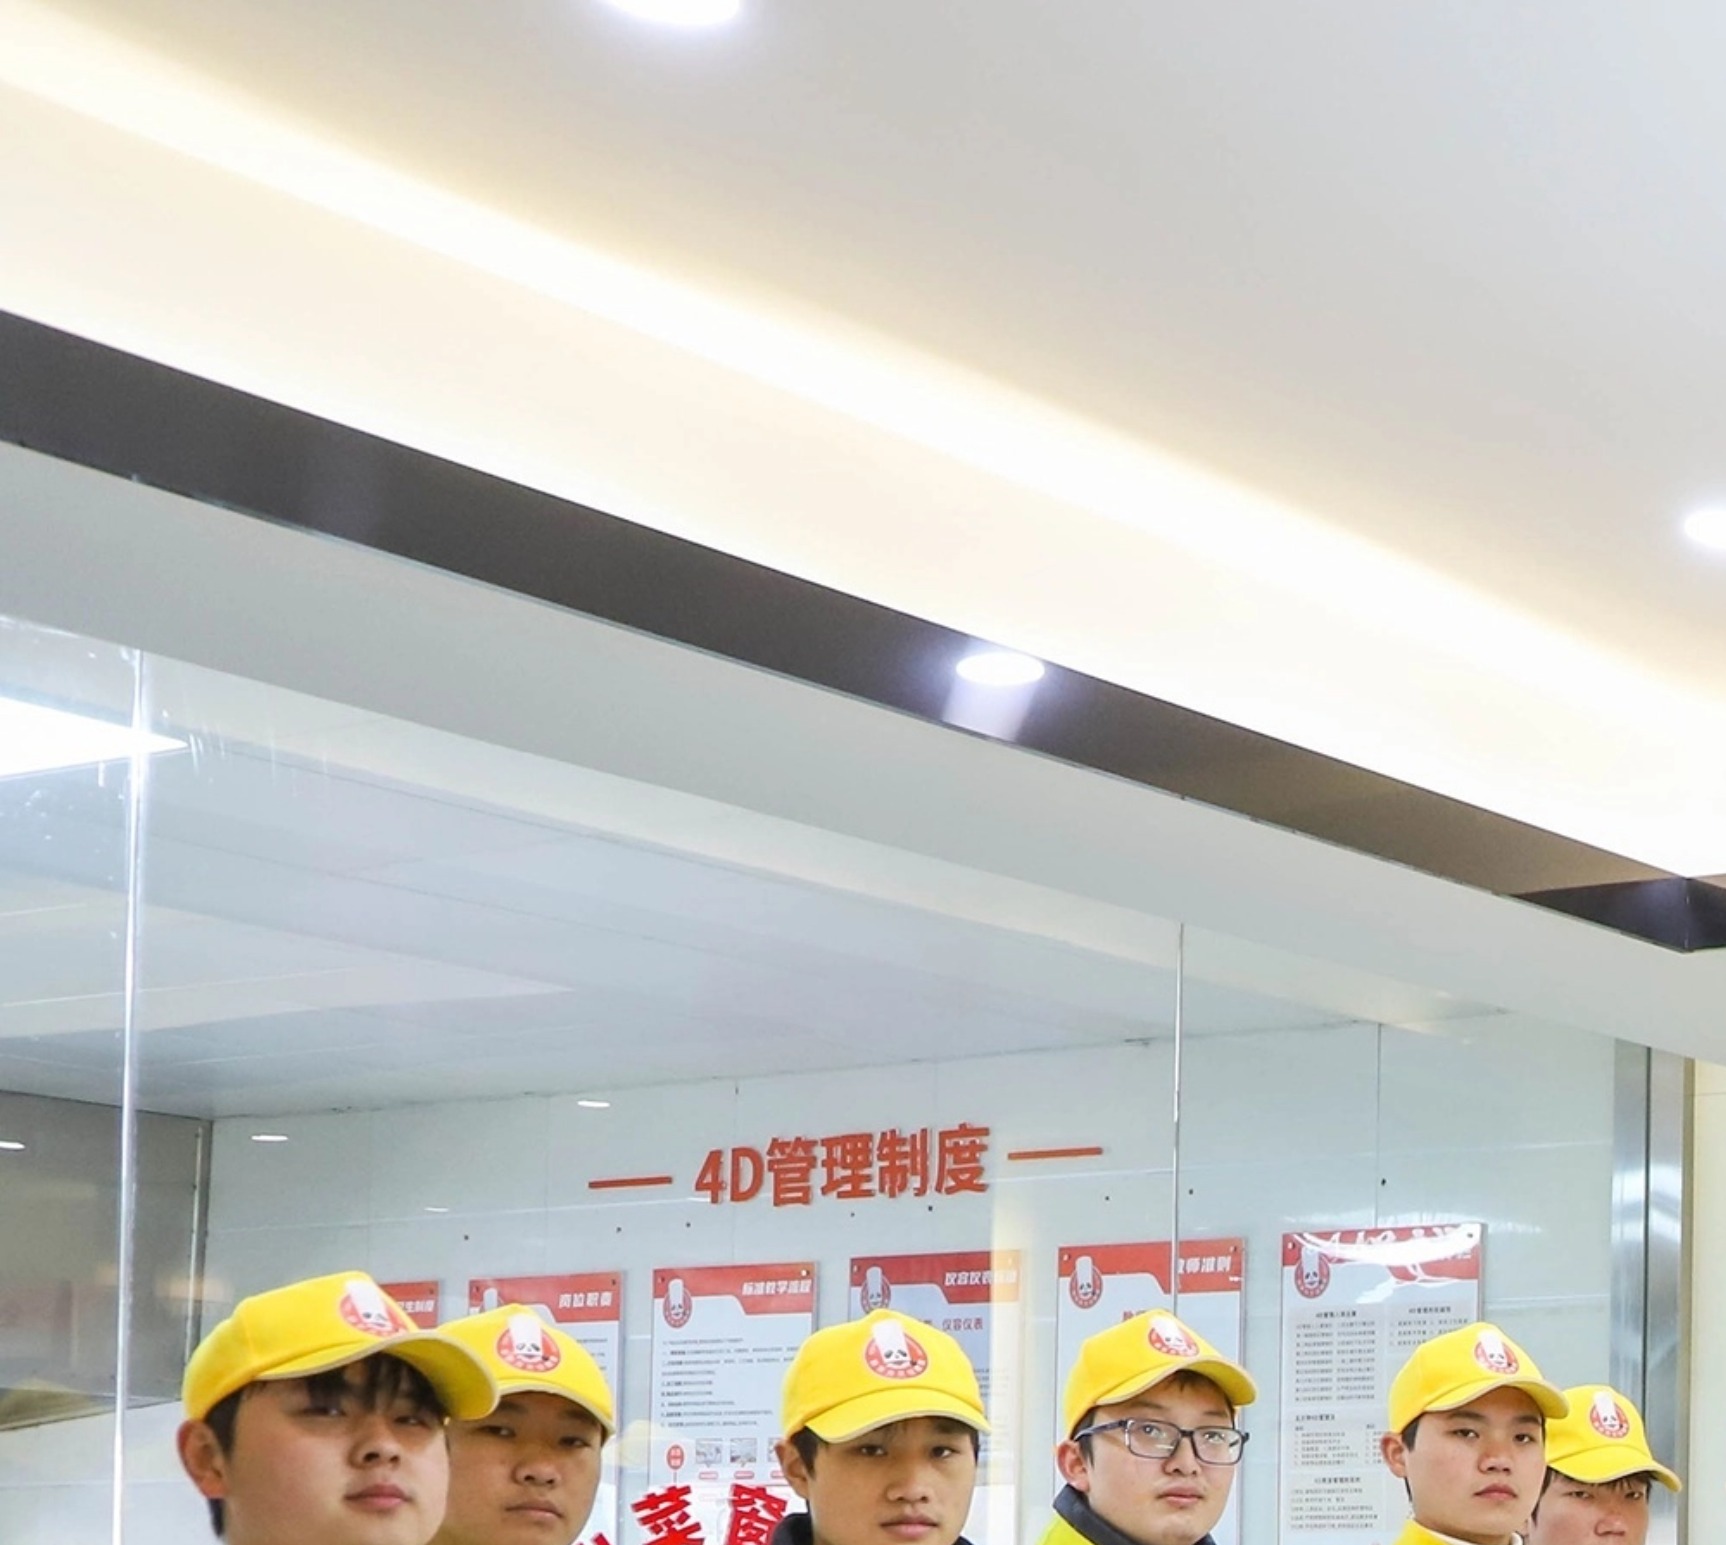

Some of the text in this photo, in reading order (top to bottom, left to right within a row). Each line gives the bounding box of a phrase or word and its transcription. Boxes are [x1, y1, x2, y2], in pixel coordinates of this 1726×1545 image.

[693, 1122, 992, 1208] 4D管理制度
[944, 1270, 1018, 1287] 仪容仪表
